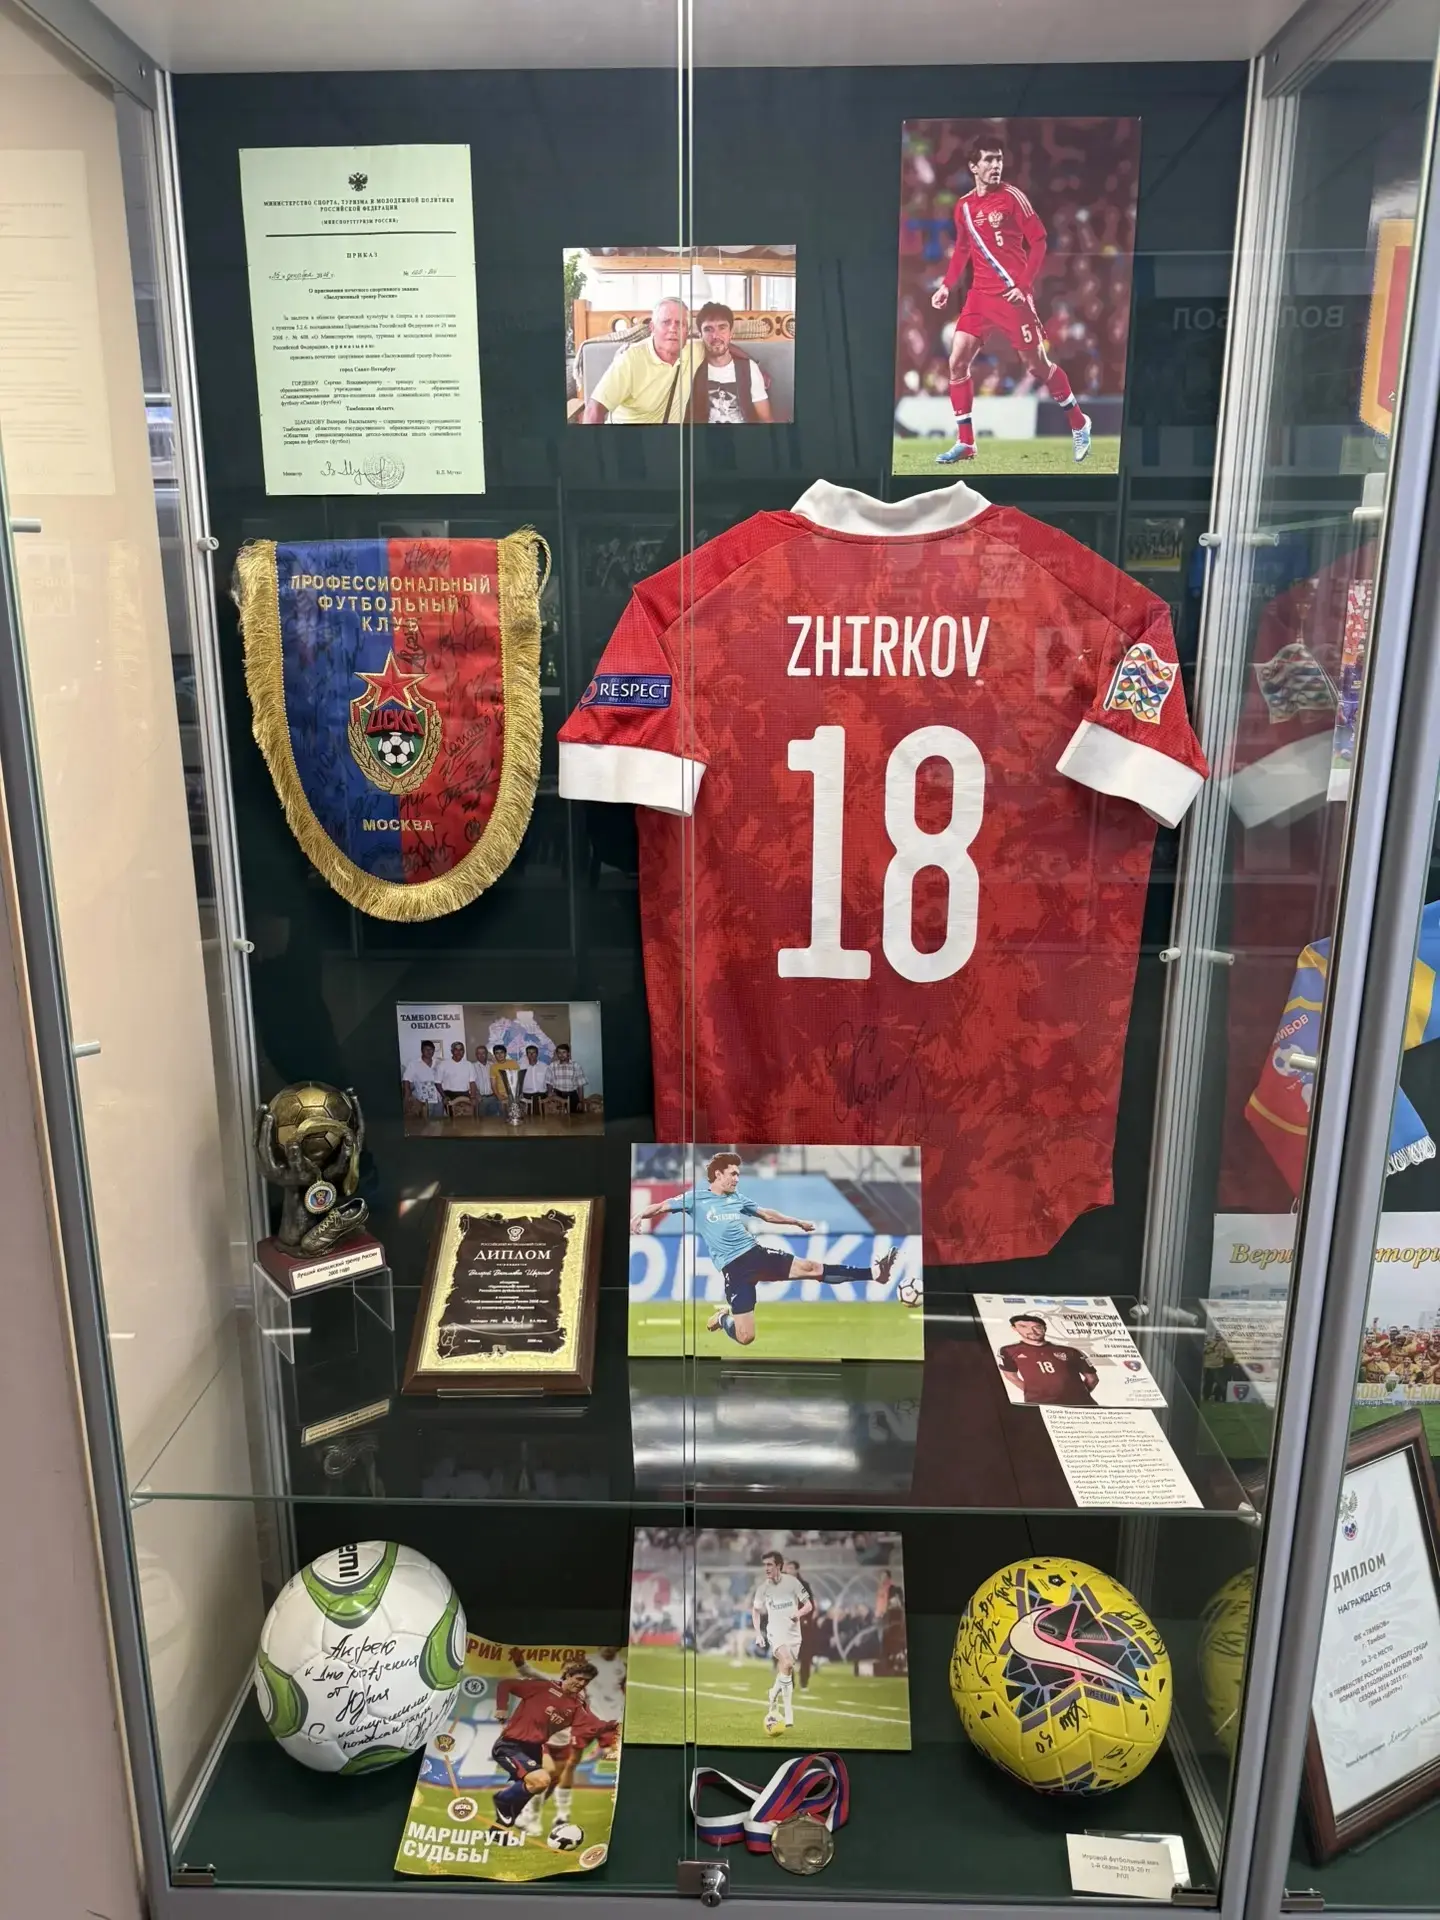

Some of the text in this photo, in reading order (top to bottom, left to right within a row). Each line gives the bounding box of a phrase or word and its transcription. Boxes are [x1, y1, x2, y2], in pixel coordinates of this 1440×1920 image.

[994, 230, 1004, 248] 5
[1021, 324, 1032, 344] 5
[290, 574, 491, 592] ПРОФЕССИОНАЛЬНЫЙ
[318, 596, 460, 614] ФУТБОЛЬНЫЙ
[362, 616, 420, 634] КЛУБ
[786, 614, 990, 678] ZHIRKOV
[598, 680, 672, 700] RESPECT
[366, 709, 422, 736] ЦСКА
[362, 818, 434, 832] МОСКВА
[778, 724, 986, 982] 18
[474, 1250, 552, 1261] ДИПЛОМ
[1036, 1361, 1056, 1374] 18
[1332, 1552, 1386, 1594] ДИПЛОМ
[1337, 1581, 1392, 1614] НАГРАЖДАЕТСЯ
[466, 1638, 503, 1661] РИЙ
[408, 1821, 526, 1847] МАРШРУТЫ
[403, 1840, 489, 1864] СУДЬБЫ
